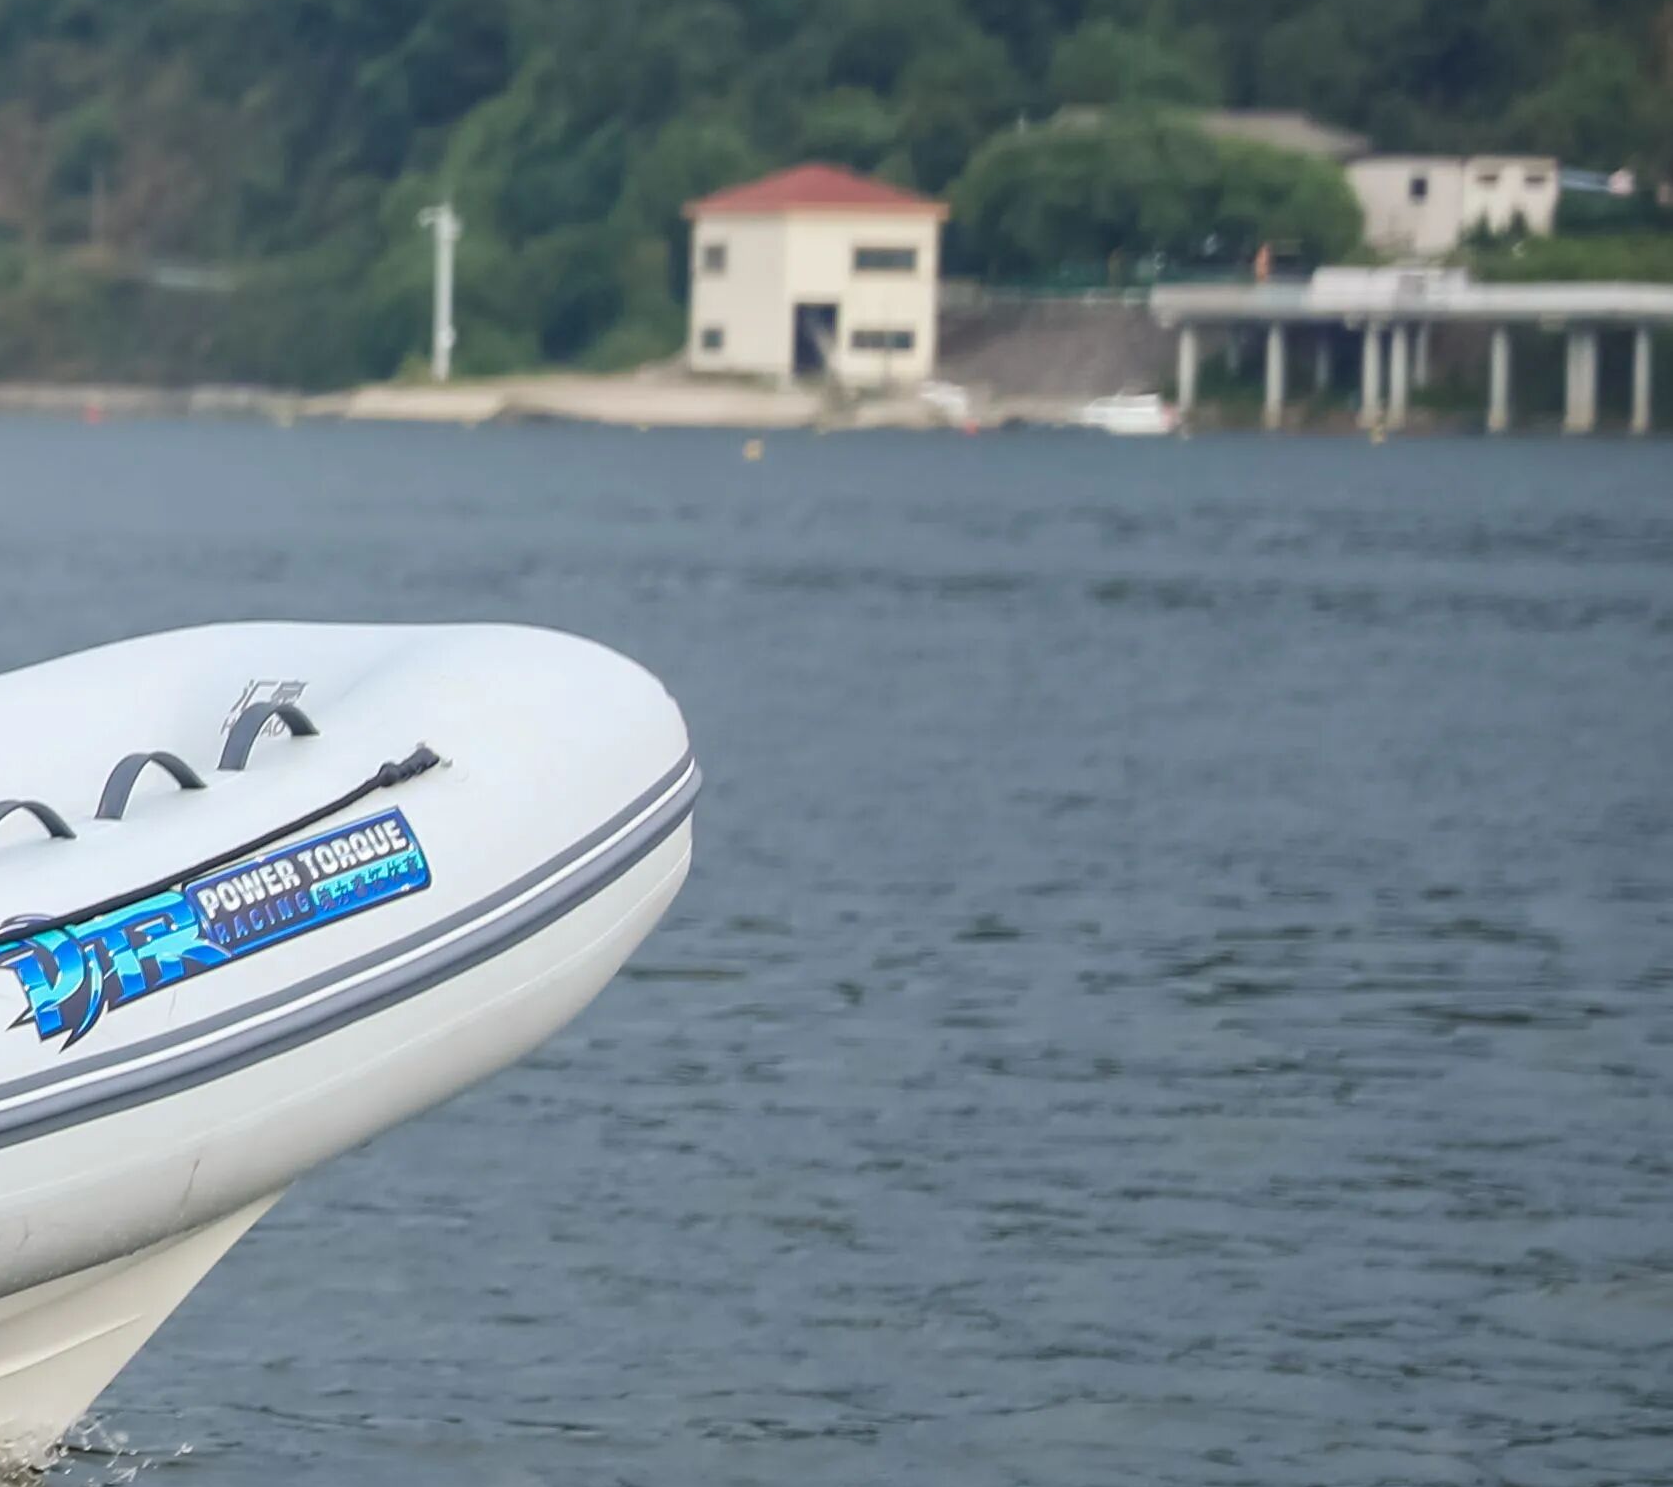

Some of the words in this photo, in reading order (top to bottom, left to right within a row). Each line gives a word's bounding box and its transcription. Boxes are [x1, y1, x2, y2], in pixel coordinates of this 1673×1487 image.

[197, 858, 302, 920] POWER
[297, 818, 408, 879] TORQUE
[213, 891, 312, 945] RACING
